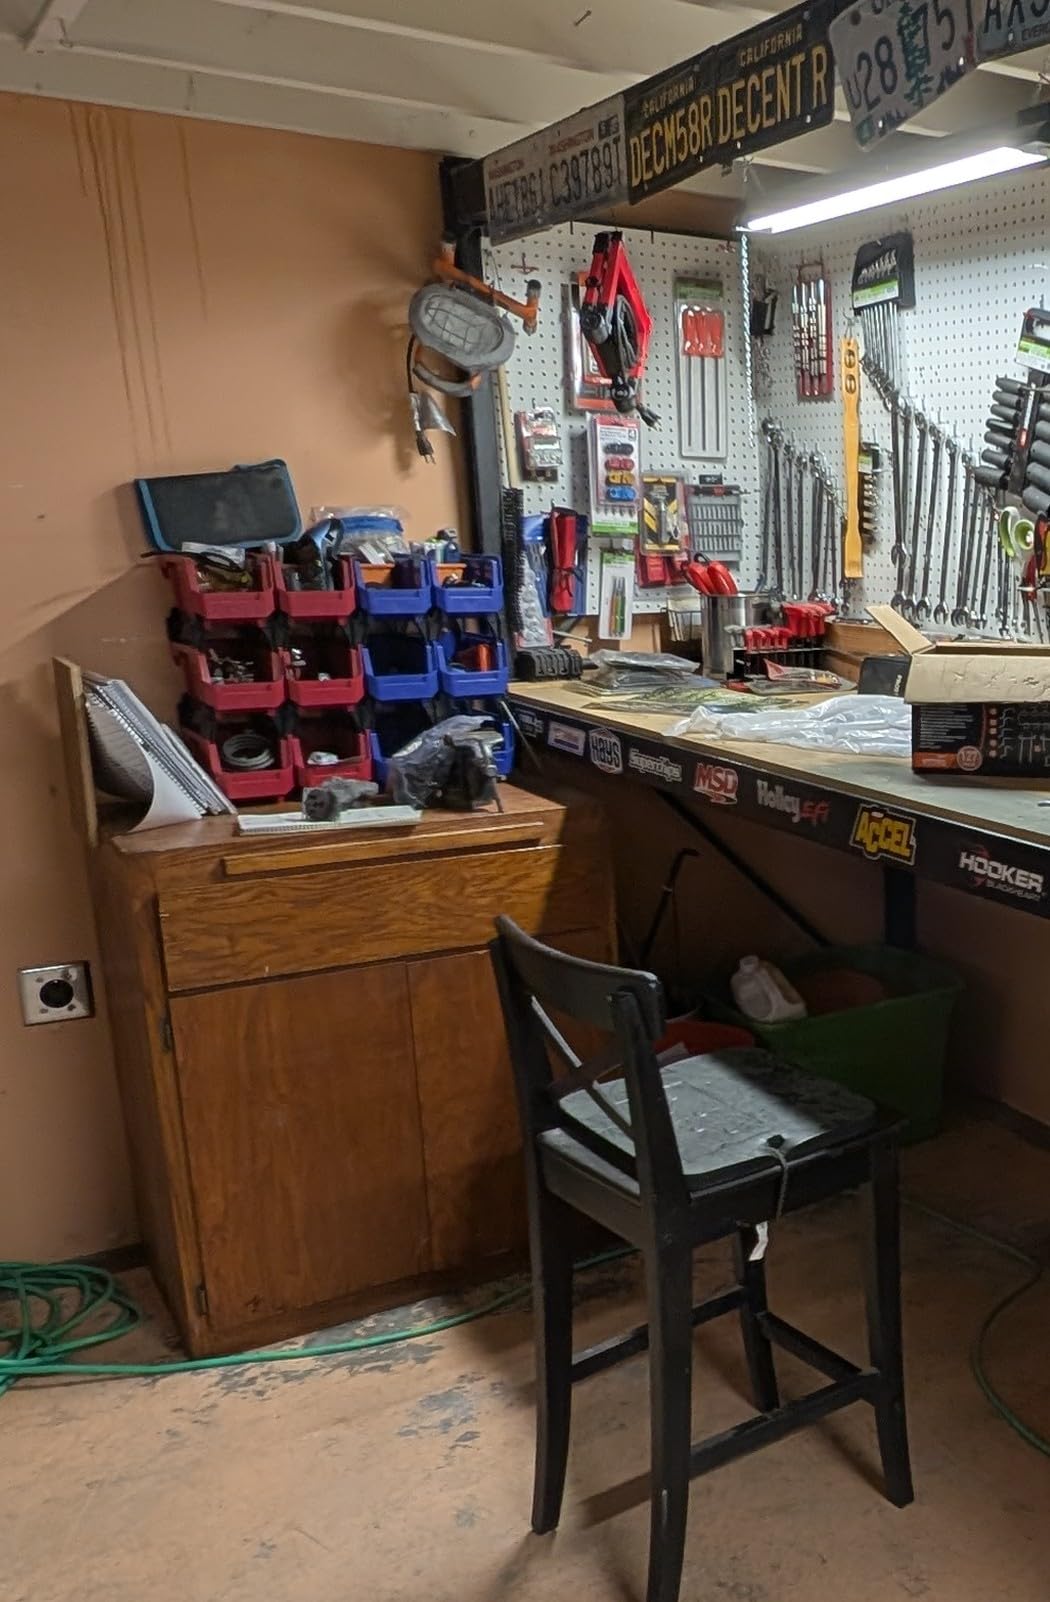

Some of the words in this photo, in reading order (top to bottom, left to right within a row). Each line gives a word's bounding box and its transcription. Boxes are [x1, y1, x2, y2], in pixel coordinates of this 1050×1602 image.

[739, 23, 803, 67] CALIFORNIA
[811, 45, 828, 109] R
[629, 95, 713, 187] DECM58R
[697, 763, 737, 793] MSD
[757, 779, 801, 823] Holley
[854, 811, 910, 858] ACCEL
[960, 852, 1044, 893] HOOKER
